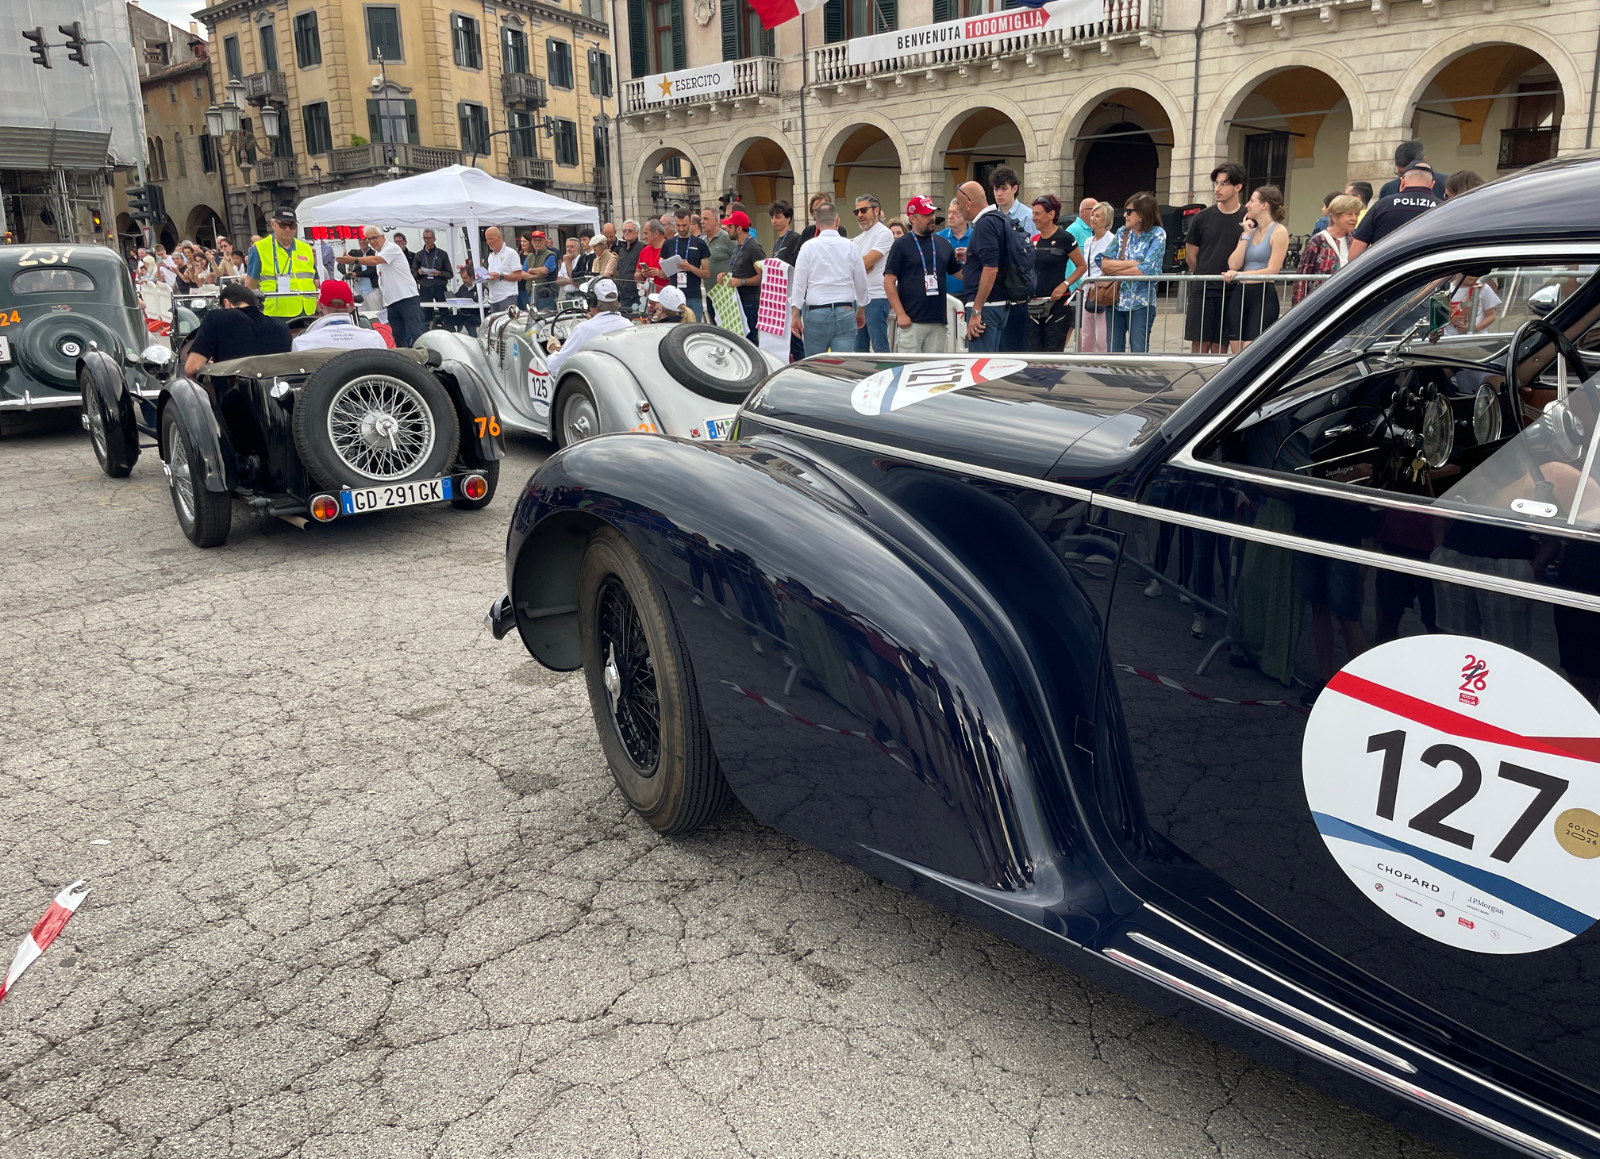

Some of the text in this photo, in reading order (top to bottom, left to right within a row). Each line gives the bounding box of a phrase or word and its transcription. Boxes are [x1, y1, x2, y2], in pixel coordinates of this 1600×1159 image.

[897, 10, 1043, 50] BENVENUTA 1000MIGLIA
[675, 73, 721, 92] ESERCITO
[1393, 197, 1437, 208] POLIZIA
[14, 247, 76, 267] 257
[905, 363, 966, 388] 127
[532, 377, 548, 399] 125
[474, 415, 501, 438] 76
[354, 490, 377, 510] GD
[385, 481, 441, 506] 291GK
[1366, 729, 1569, 863] 127
[1565, 829, 1597, 846] 2026
[1568, 822, 1599, 838] GOLD
[1377, 862, 1440, 893] CHOPARD
